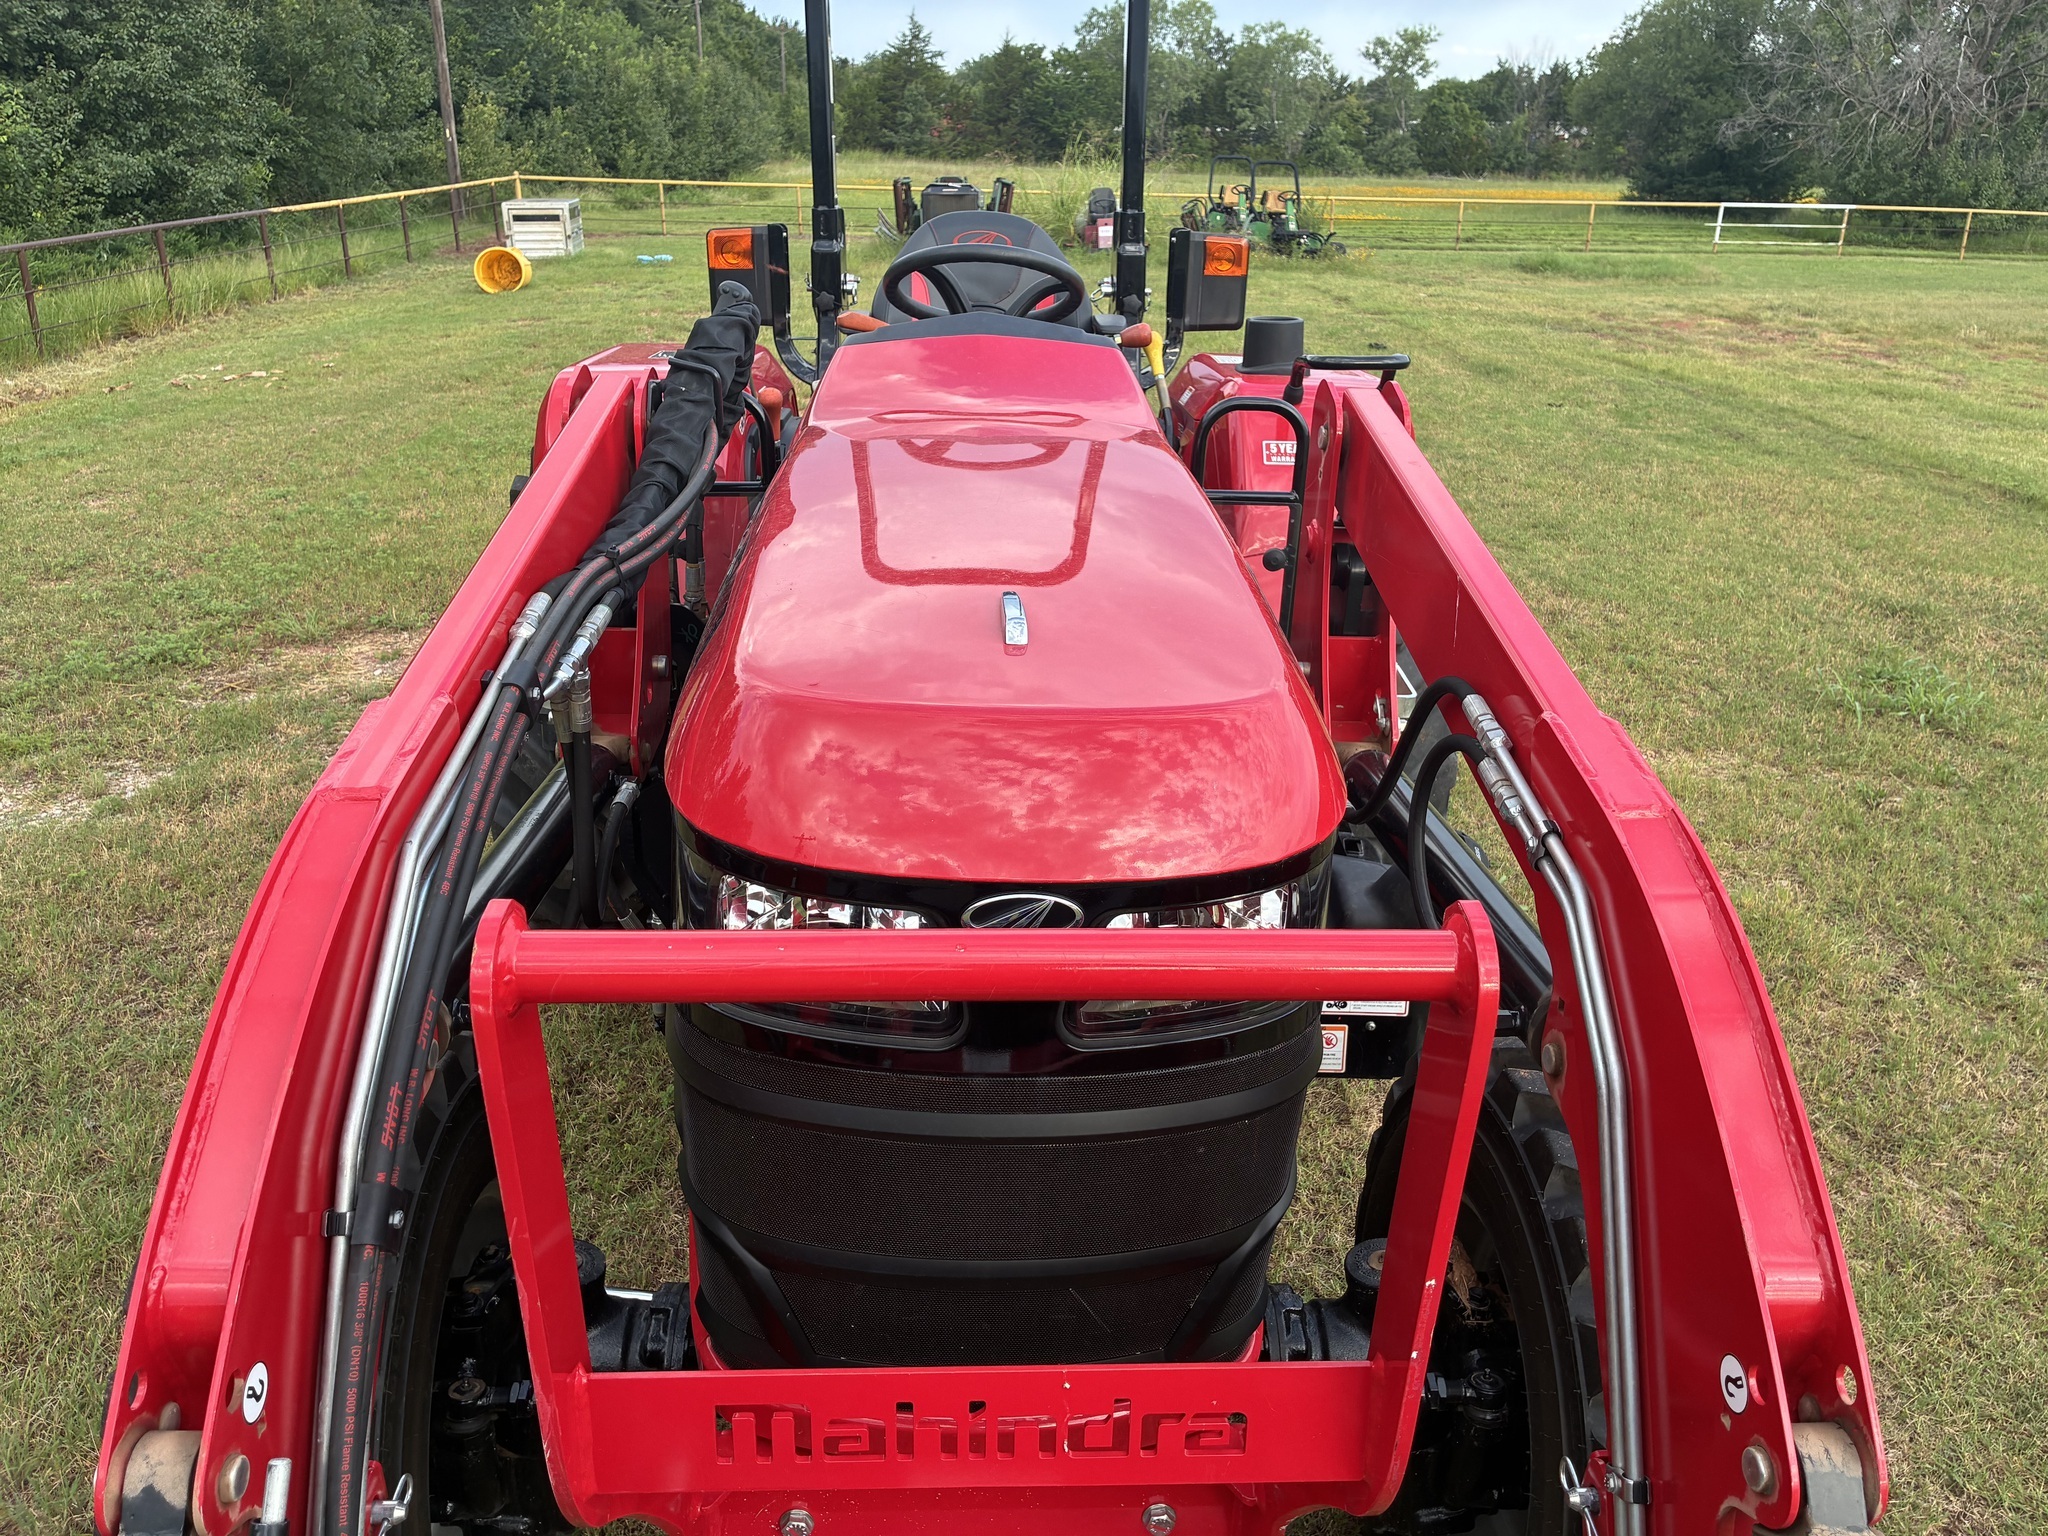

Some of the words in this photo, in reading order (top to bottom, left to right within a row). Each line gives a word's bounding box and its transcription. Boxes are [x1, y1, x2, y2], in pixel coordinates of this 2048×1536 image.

[1269, 443, 1278, 454] 5
[495, 713, 507, 731] LONG
[460, 816, 470, 829] PSI
[454, 827, 467, 847] Flame
[444, 847, 460, 879] Resistant
[402, 1092, 415, 1122] LONG
[355, 1281, 370, 1319] 100R16
[347, 1345, 363, 1382] (DN10)
[345, 1387, 358, 1413] 5000
[344, 1415, 356, 1434] PSI
[341, 1437, 354, 1471] Flame
[338, 1473, 351, 1526] Resistant
